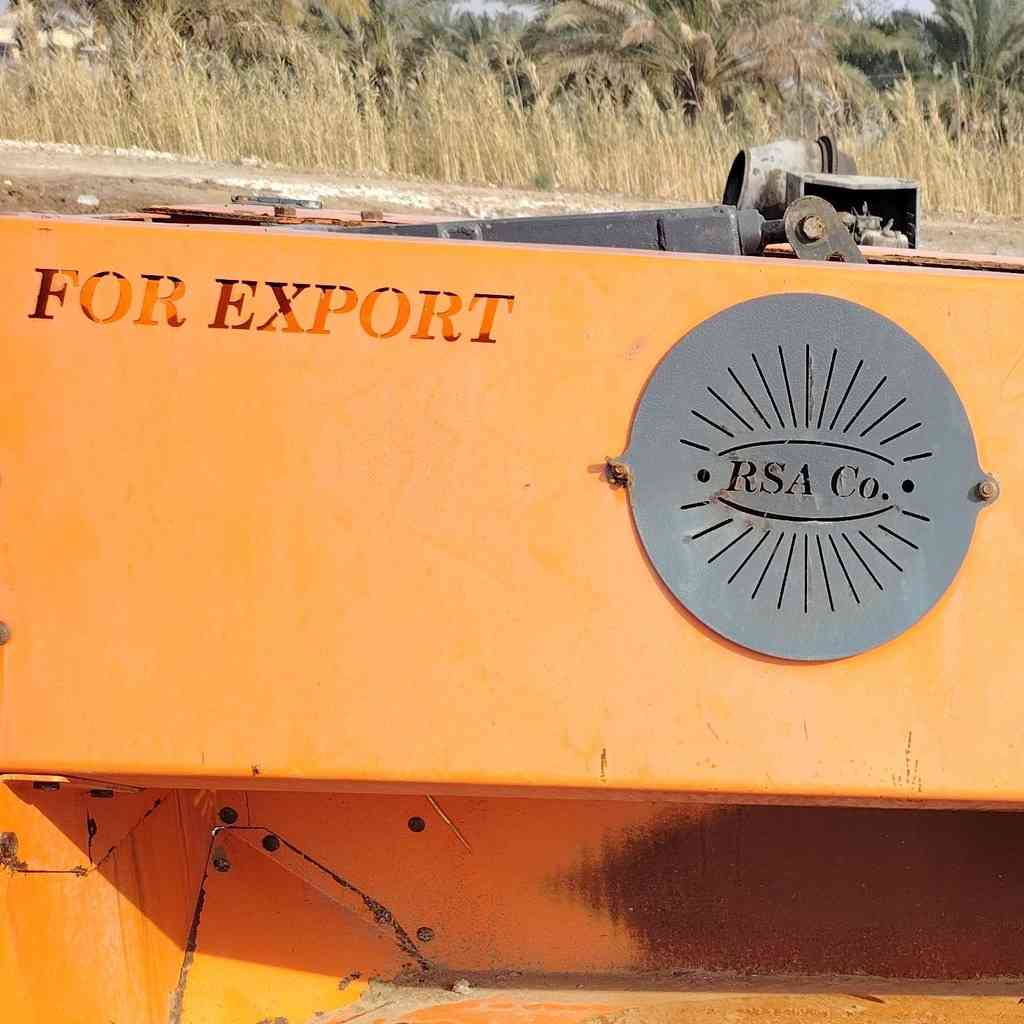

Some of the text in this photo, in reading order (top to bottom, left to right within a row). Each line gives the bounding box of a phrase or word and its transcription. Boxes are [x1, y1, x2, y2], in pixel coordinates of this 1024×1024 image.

[28, 267, 516, 344] FOR EXPORT
[725, 460, 889, 501] RSA Co.
